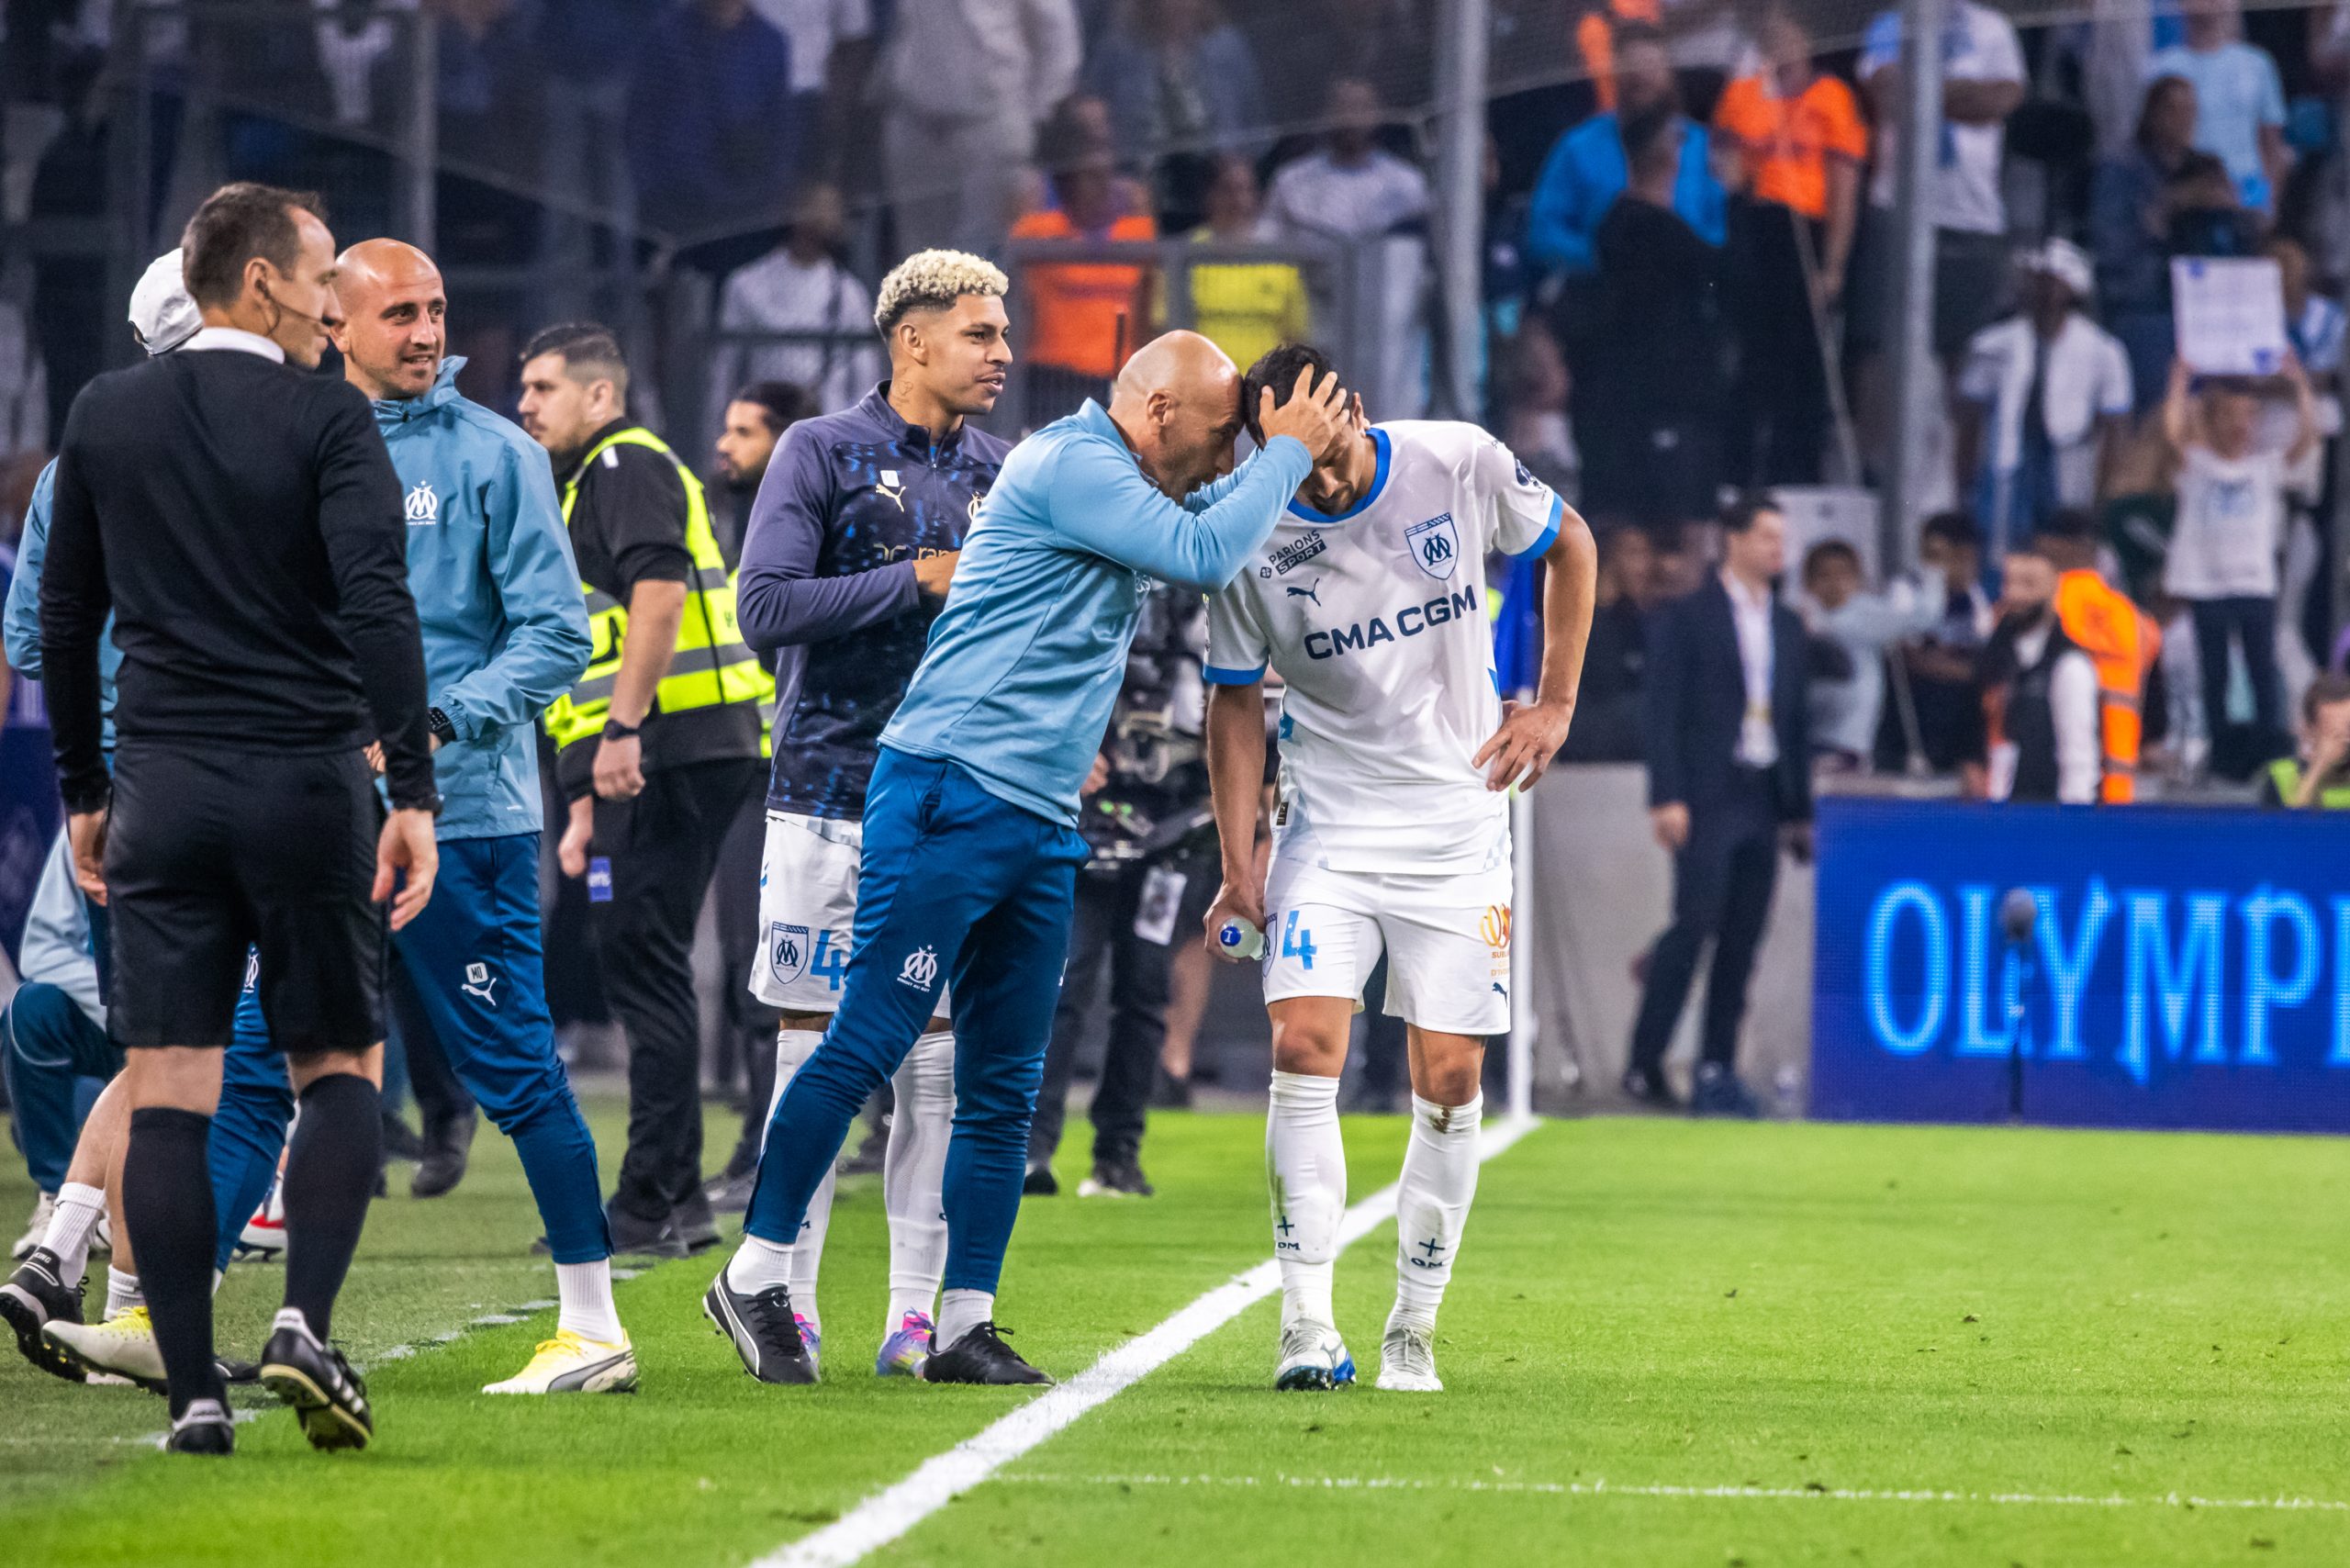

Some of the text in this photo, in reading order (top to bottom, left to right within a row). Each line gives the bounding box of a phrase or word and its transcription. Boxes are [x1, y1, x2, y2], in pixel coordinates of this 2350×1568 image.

[1268, 529, 1321, 566] PARIONS
[1278, 540, 1324, 575] SPORT
[1304, 584, 1478, 660] CMA CGM
[1281, 911, 1318, 970] 4
[809, 929, 846, 991] 4
[1278, 1241, 1301, 1251] OM
[1411, 1258, 1443, 1269] OM
